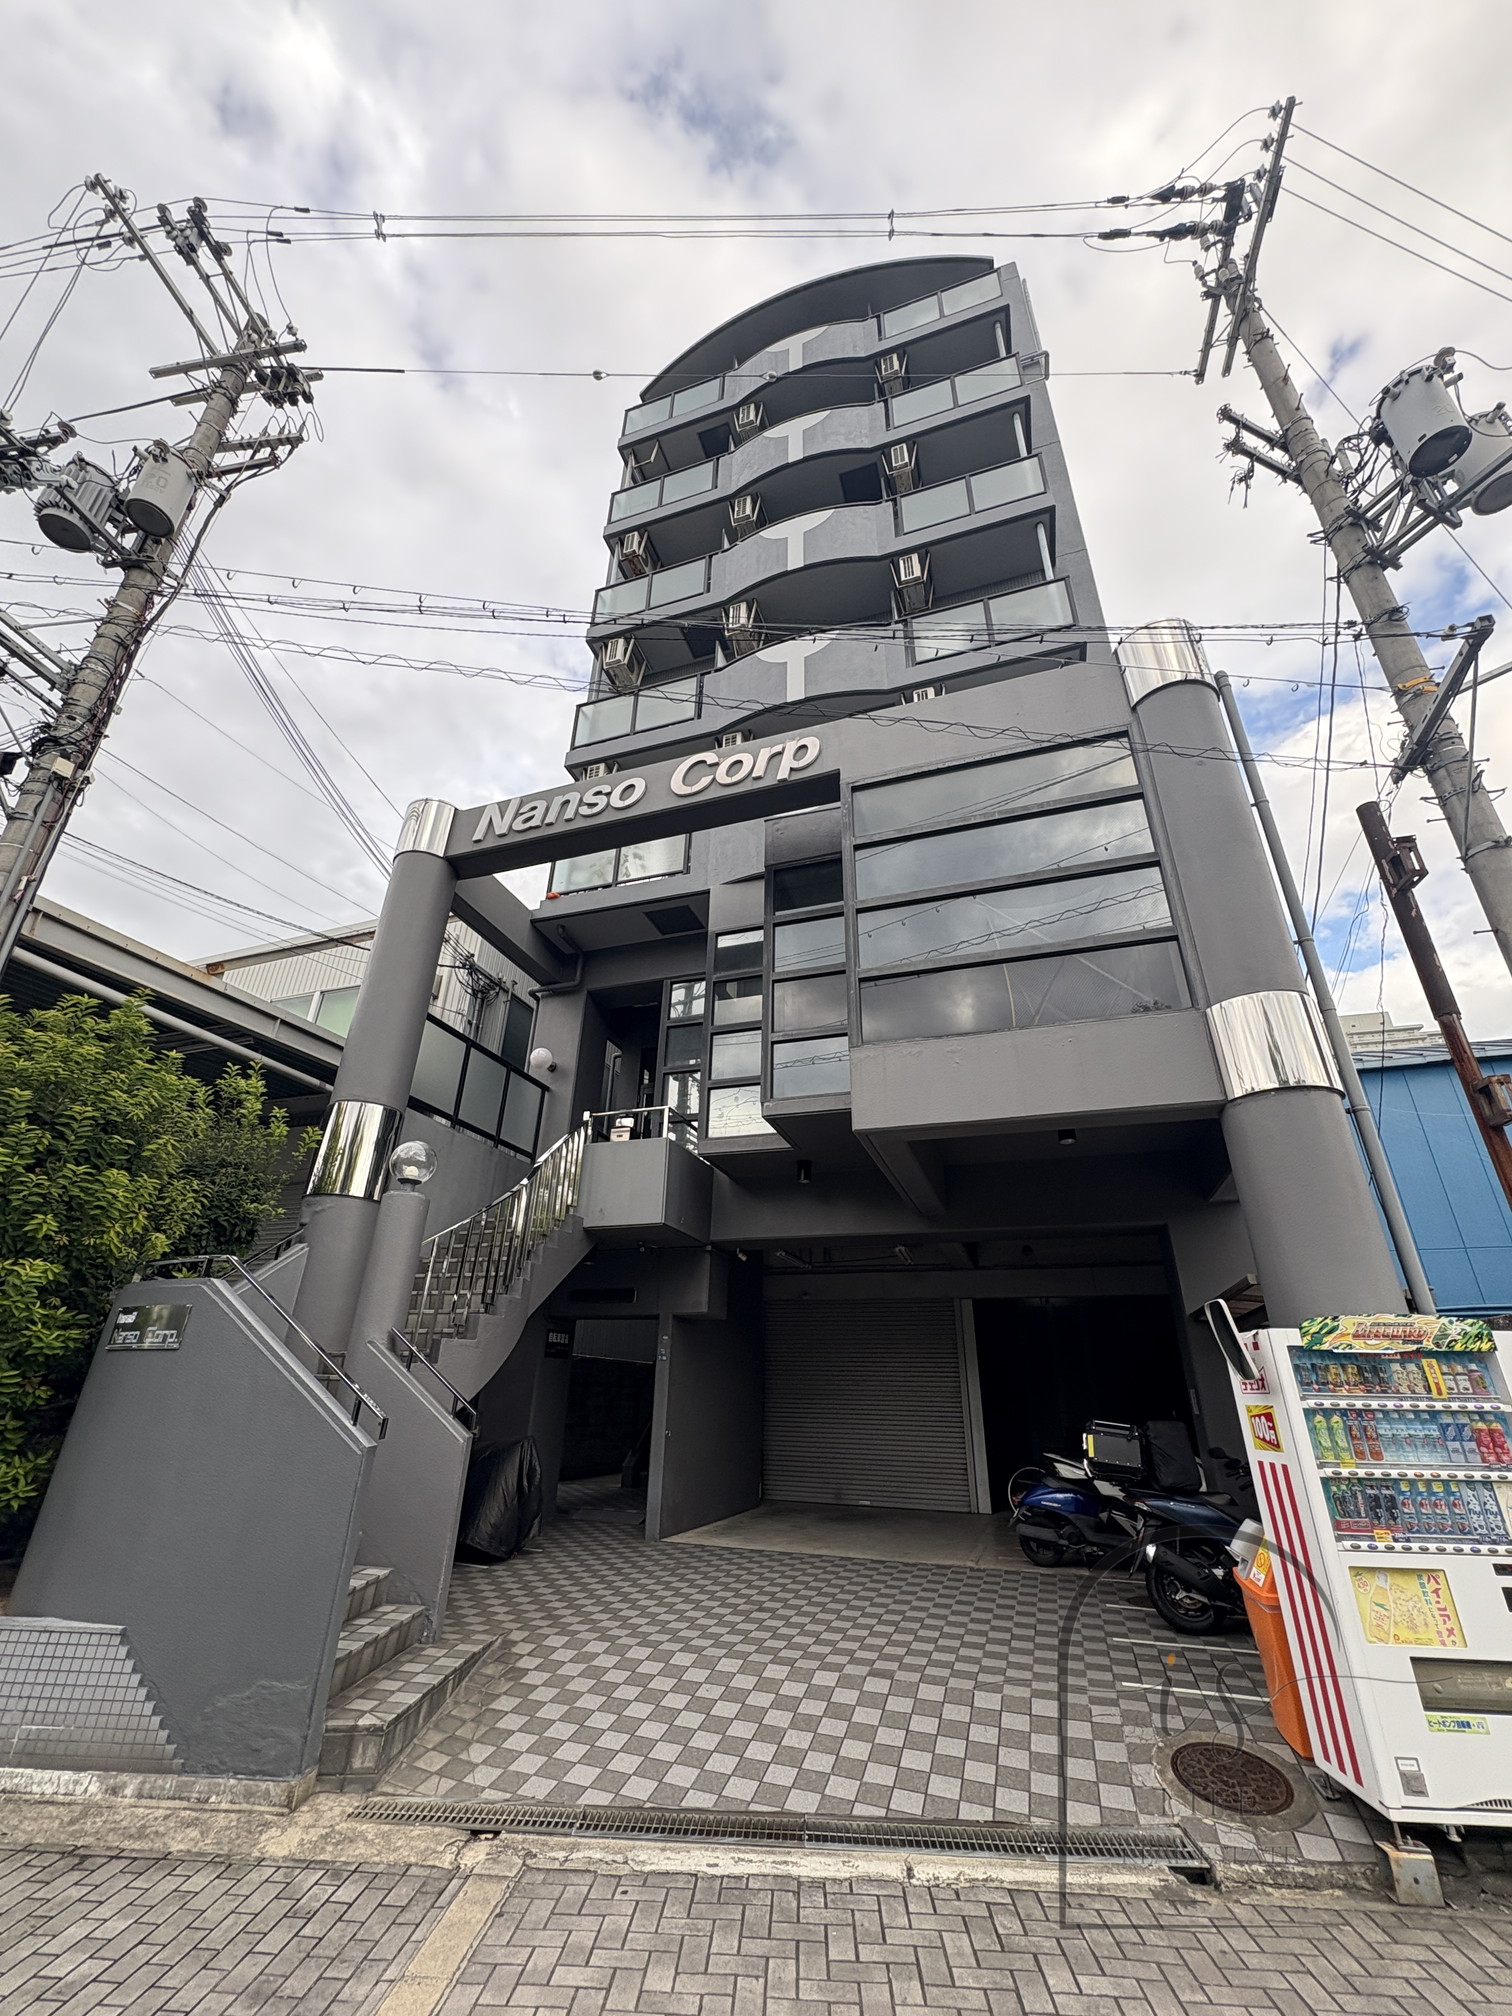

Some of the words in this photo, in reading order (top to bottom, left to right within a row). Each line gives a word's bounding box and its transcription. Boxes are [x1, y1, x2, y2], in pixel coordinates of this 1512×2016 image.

[472, 777, 647, 843] Nanso
[669, 734, 822, 798] Corp
[111, 1327, 141, 1344] Nanso
